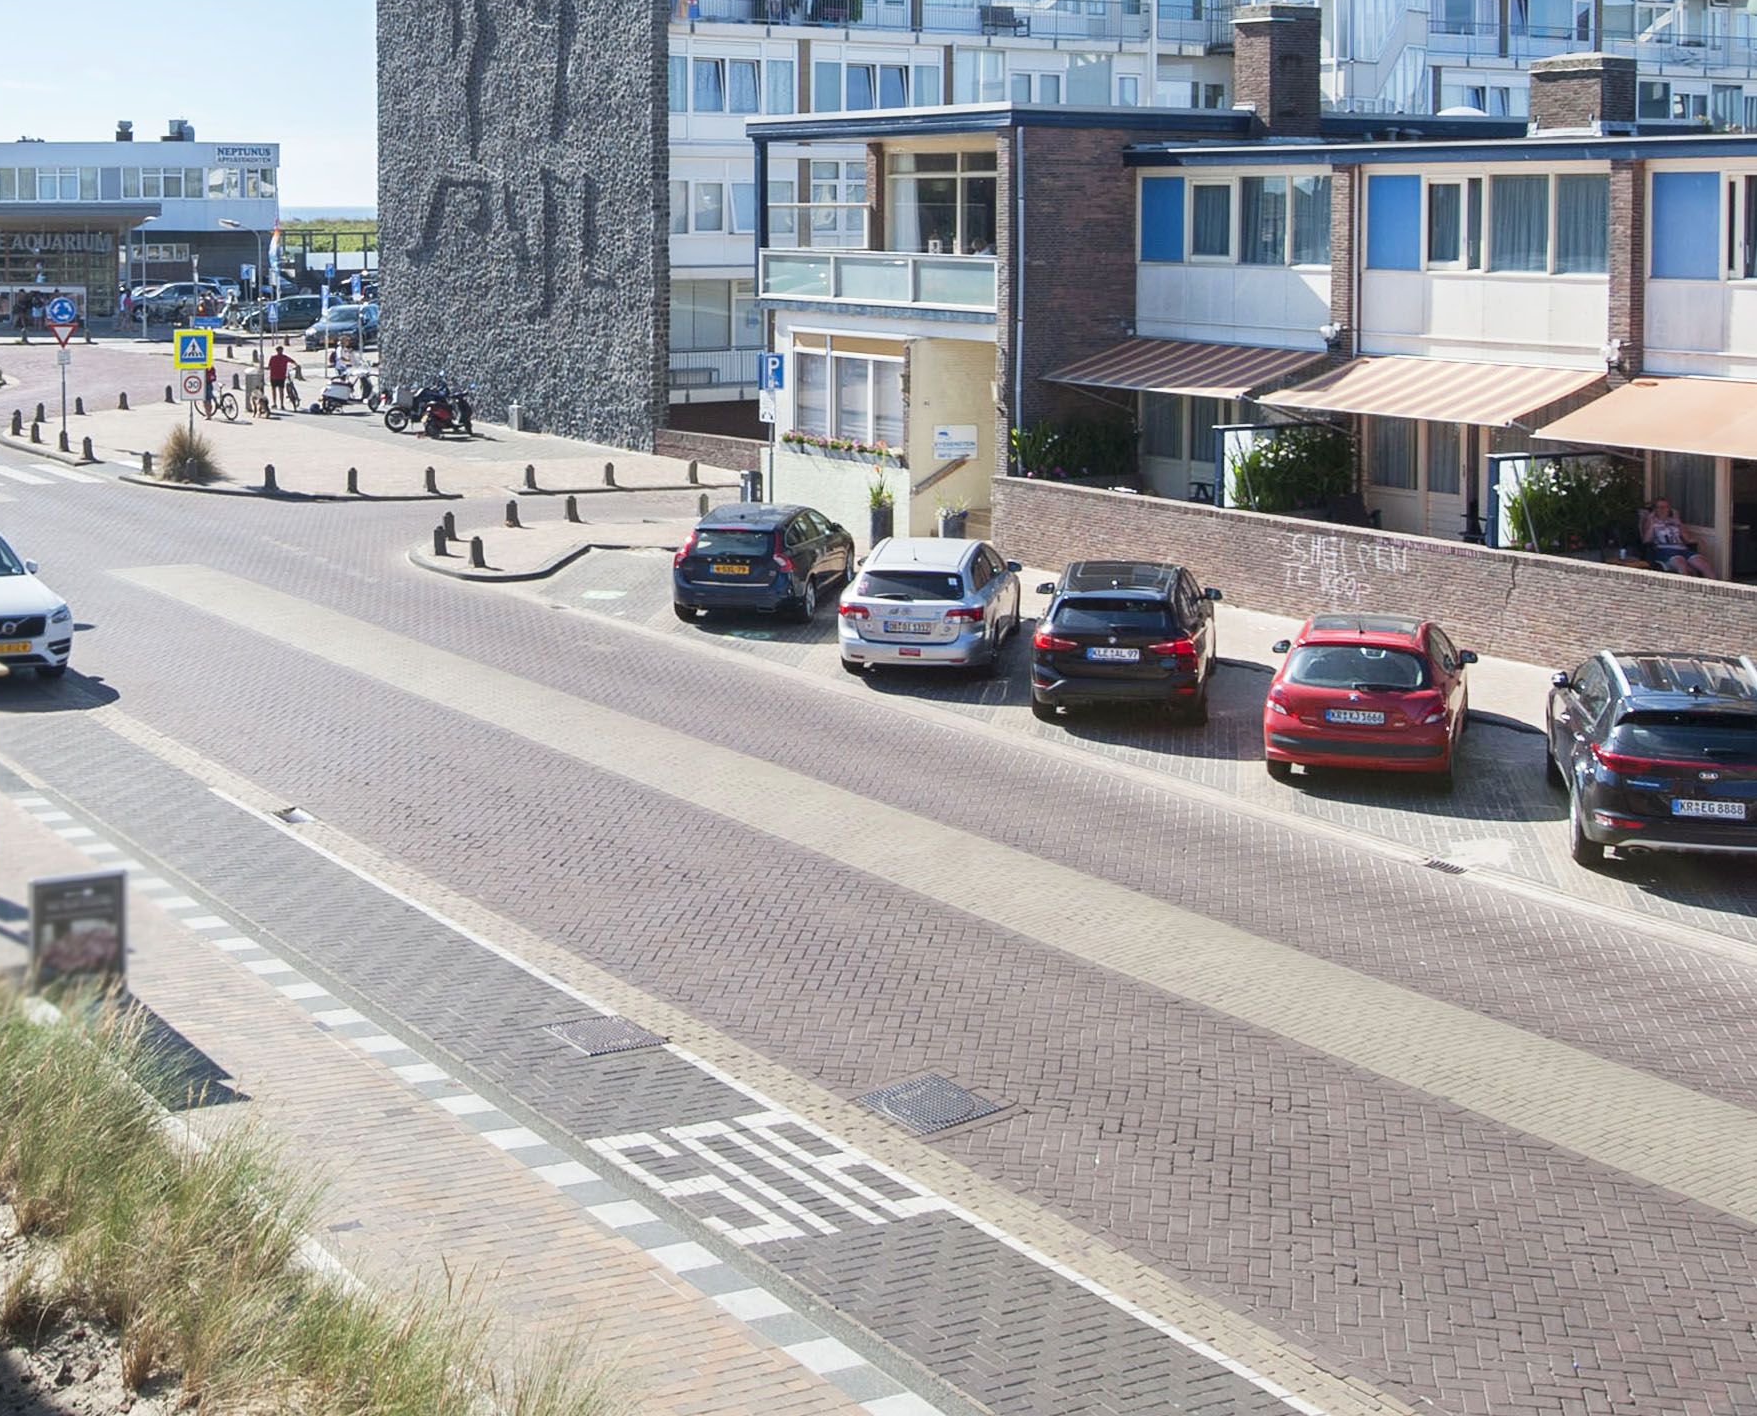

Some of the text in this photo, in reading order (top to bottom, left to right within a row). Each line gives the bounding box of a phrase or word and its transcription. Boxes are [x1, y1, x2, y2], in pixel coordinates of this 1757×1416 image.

[217, 147, 271, 157] NEPTUNUS
[11, 233, 112, 253] AQUARIUM
[768, 357, 780, 376] P
[188, 381, 199, 389] 30
[1680, 802, 1694, 812] KR
[1701, 803, 1715, 814] EG
